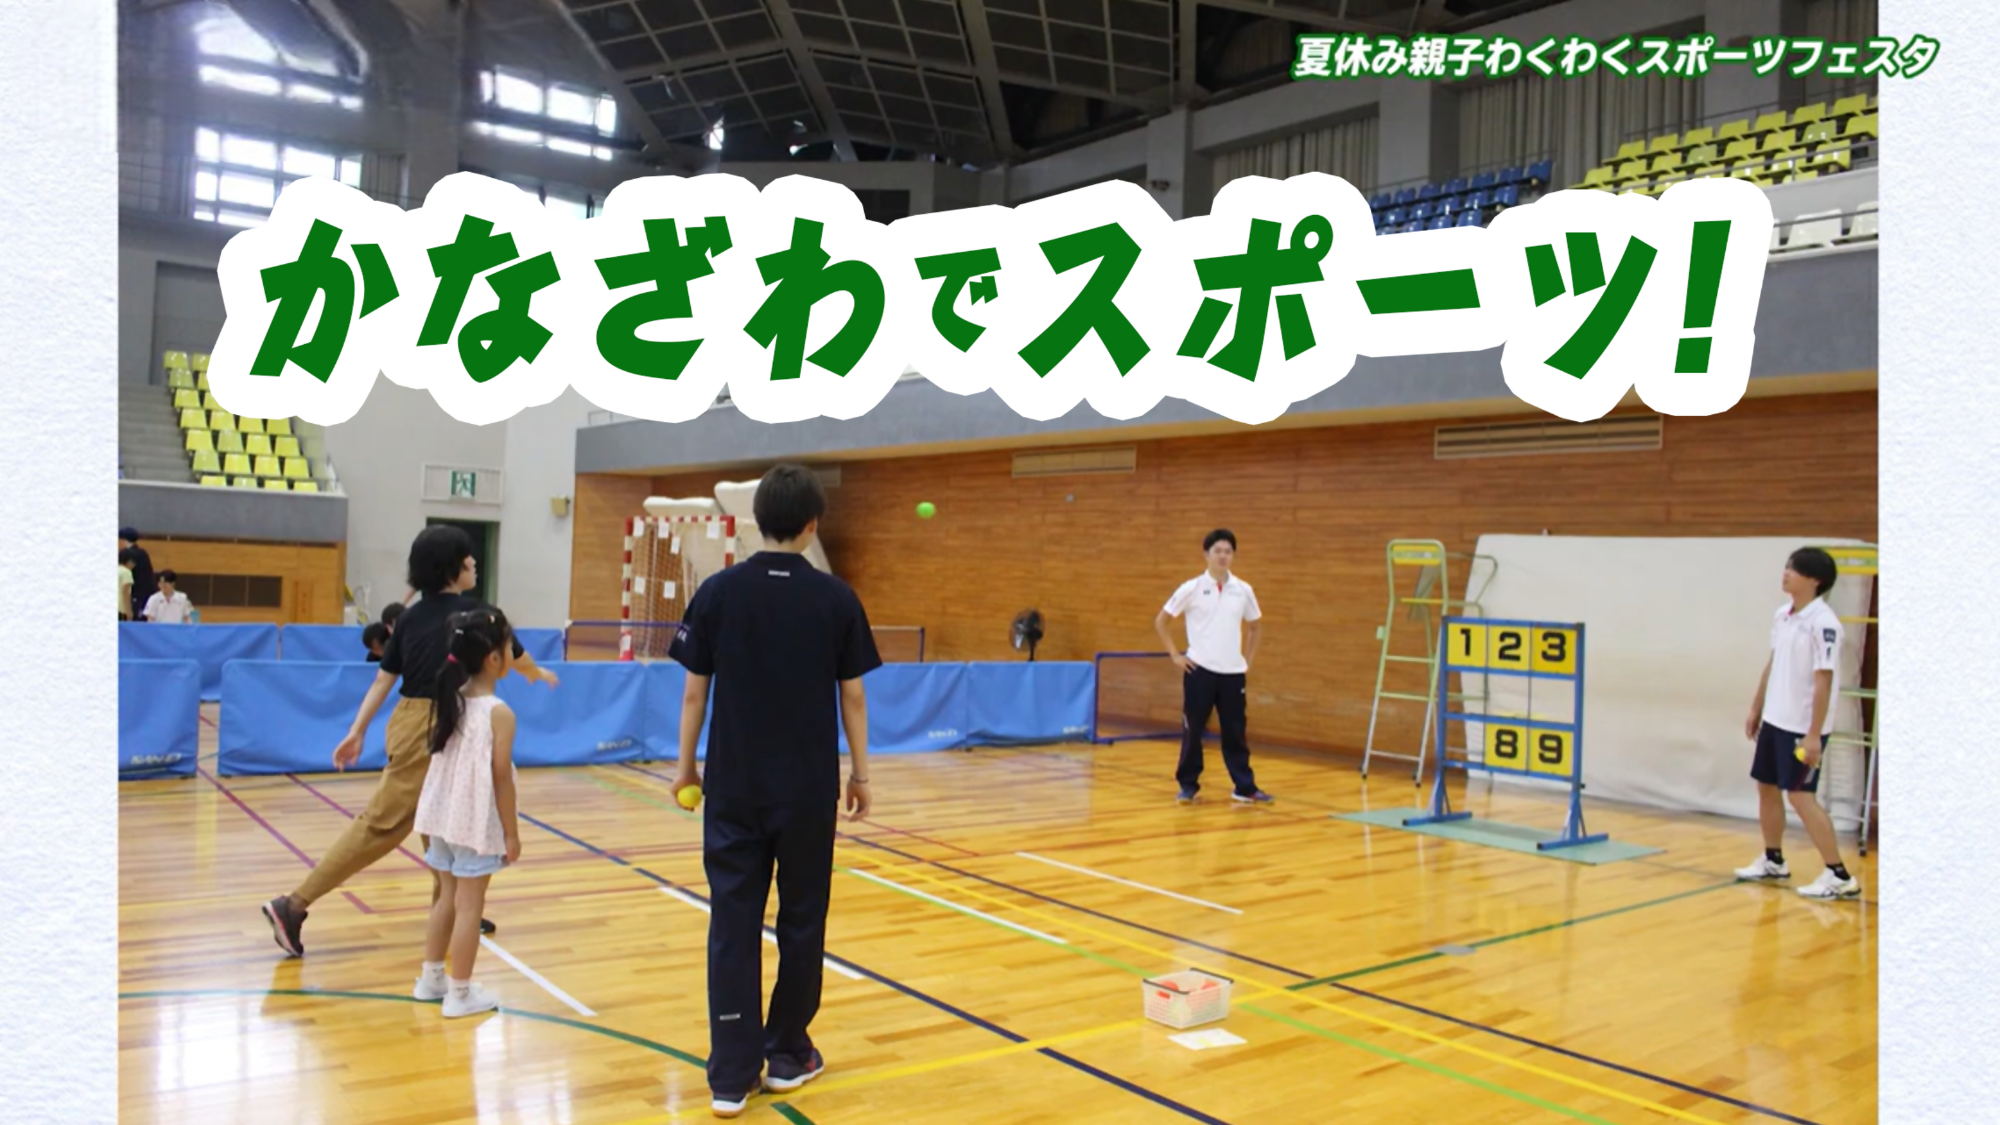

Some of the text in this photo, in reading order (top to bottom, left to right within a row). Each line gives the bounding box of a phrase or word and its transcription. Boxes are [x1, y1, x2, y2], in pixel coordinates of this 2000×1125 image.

[1460, 628, 1566, 662] 1 2 3
[1494, 729, 1563, 764] 8 9
